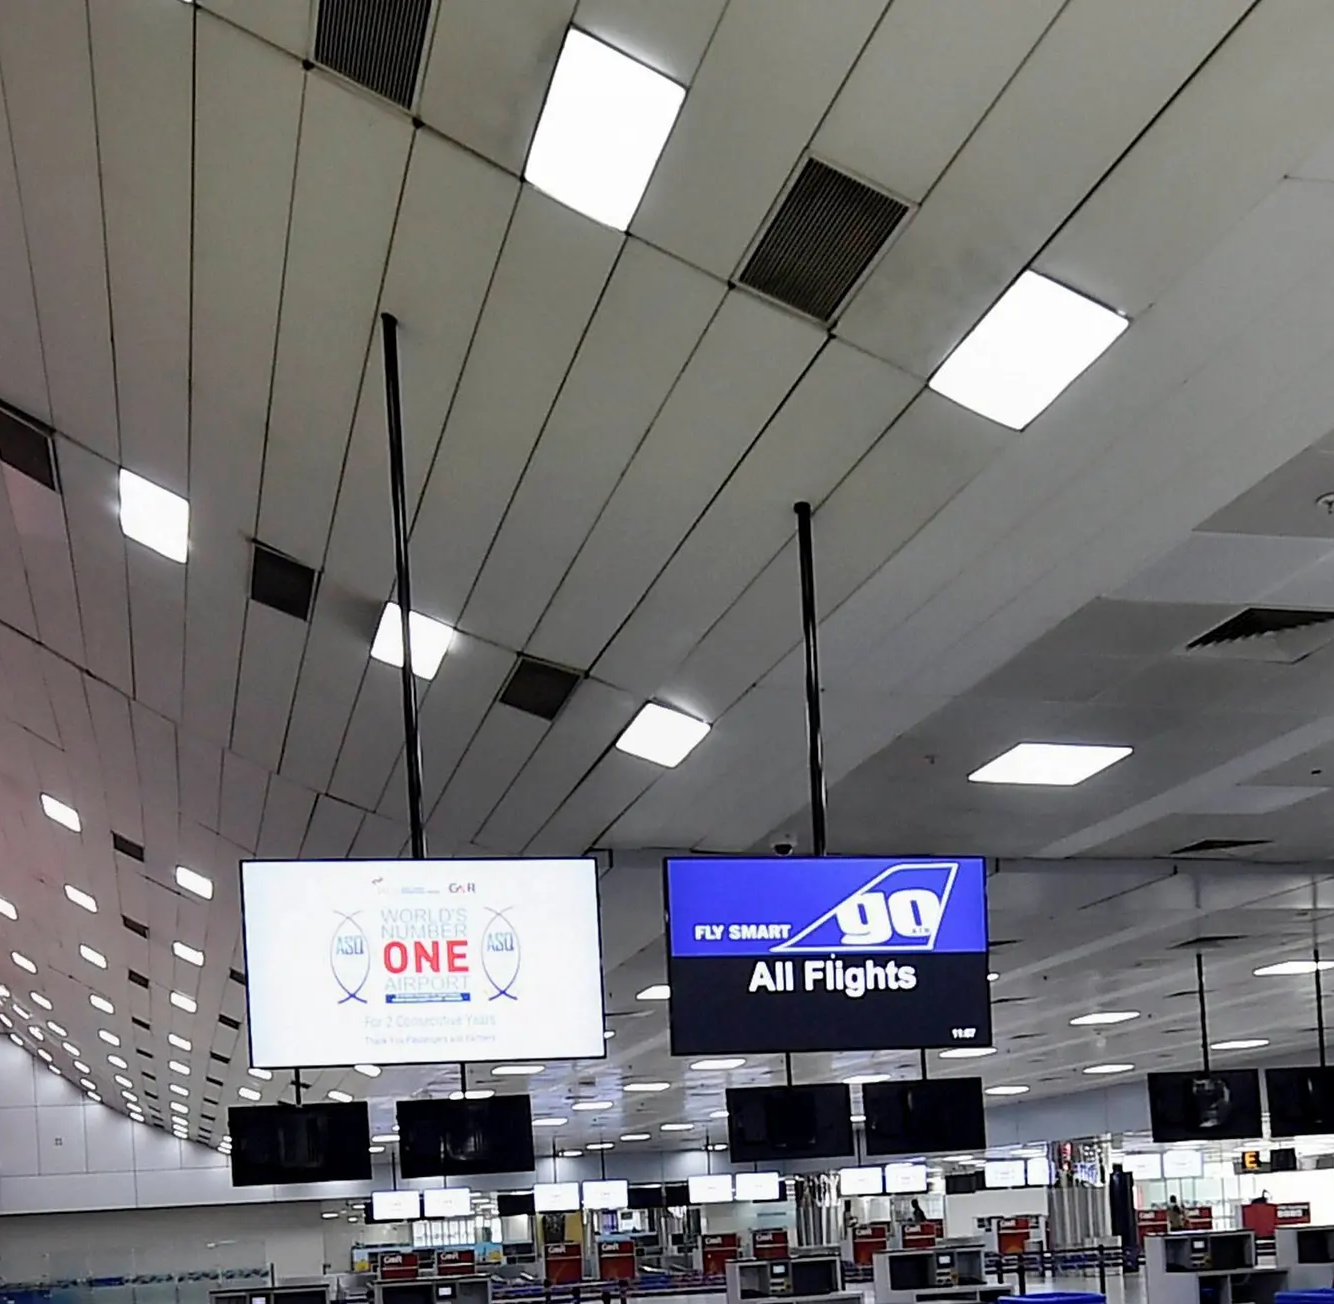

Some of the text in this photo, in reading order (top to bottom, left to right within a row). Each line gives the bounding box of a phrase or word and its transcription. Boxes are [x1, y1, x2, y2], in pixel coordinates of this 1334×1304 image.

[380, 908, 467, 923] WORLD'S
[381, 923, 467, 940] NUMBER
[695, 924, 791, 940] FLY SMART
[383, 940, 470, 974] ONE
[385, 976, 470, 991] AIRPORT
[749, 955, 916, 998] All Flights
[1244, 1152, 1257, 1168] E
